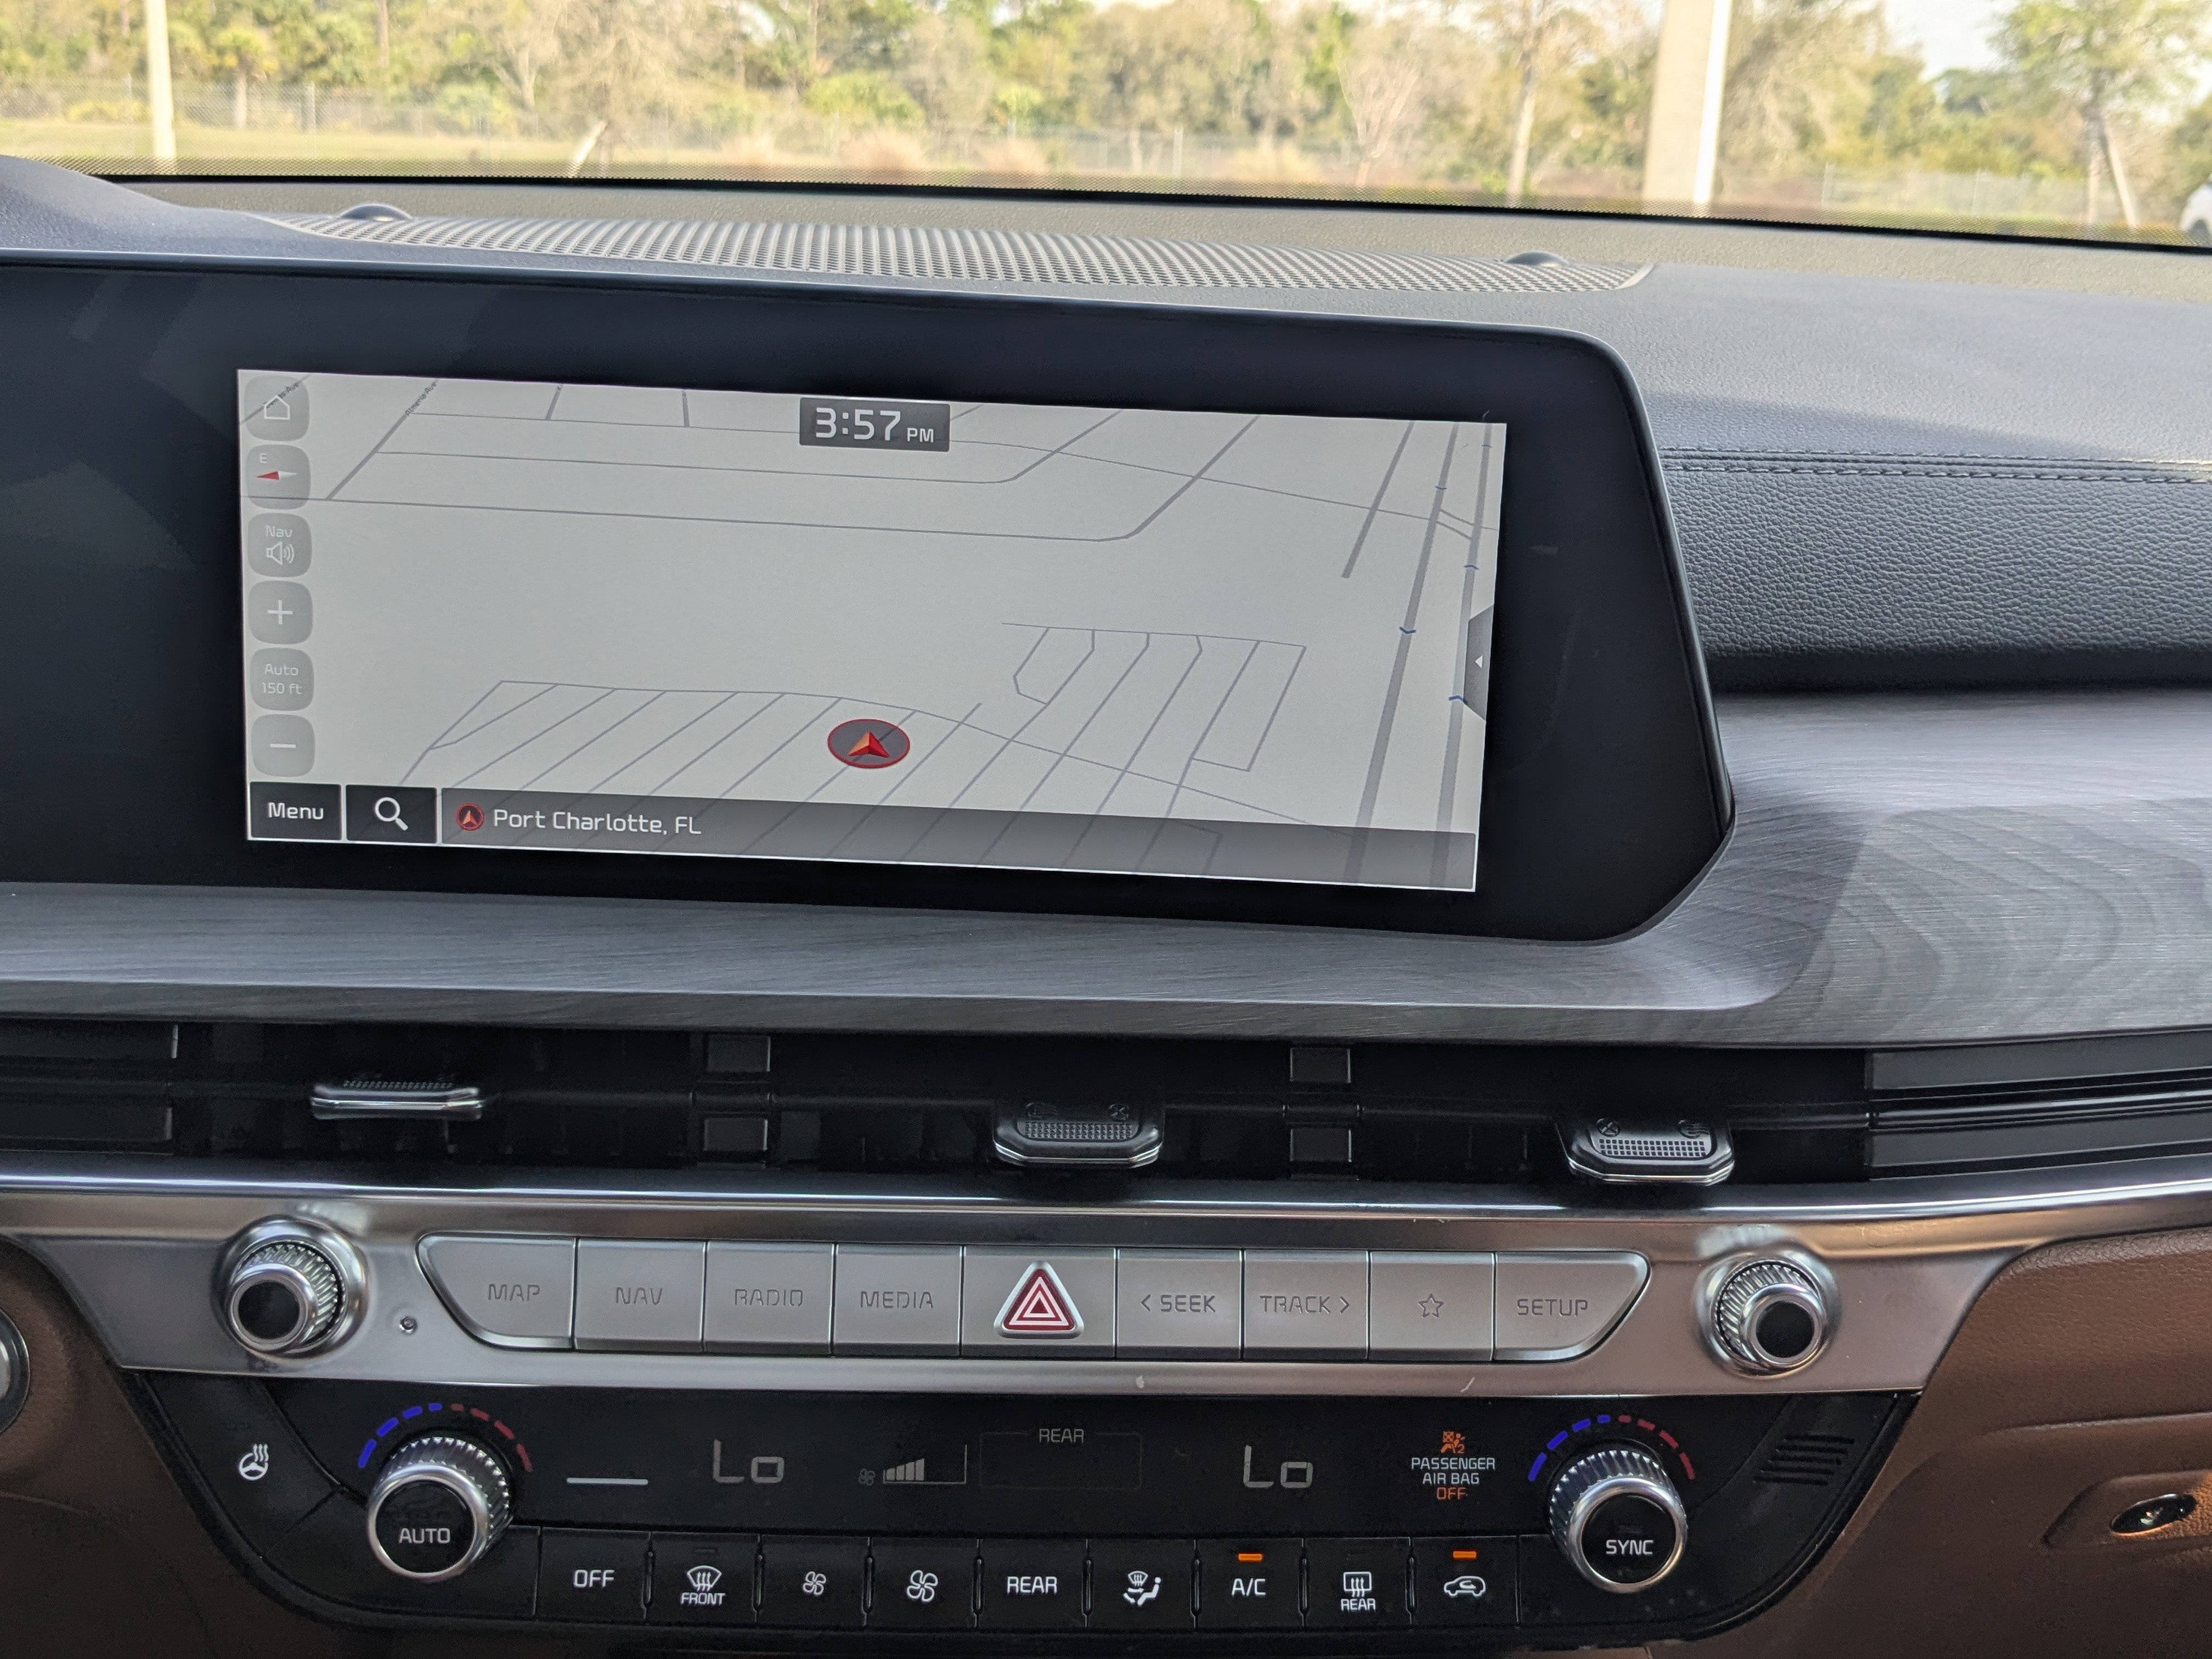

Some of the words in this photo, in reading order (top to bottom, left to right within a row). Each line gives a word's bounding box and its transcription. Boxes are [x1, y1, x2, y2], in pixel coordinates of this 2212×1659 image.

[405, 393, 427, 416] Almeria
[425, 381, 437, 394] Ave
[815, 407, 901, 441] 3:57
[907, 427, 934, 443] PM
[259, 453, 268, 464] E
[265, 525, 294, 538] Nav
[264, 663, 299, 675] Auto
[262, 682, 285, 694] 150
[289, 682, 302, 695] ft
[267, 802, 324, 821] Menu
[493, 809, 546, 829] Port
[552, 811, 668, 836] Charlotte,
[675, 816, 702, 835] FL
[487, 1283, 541, 1302] MAP
[615, 1287, 663, 1305] NAV
[733, 1289, 804, 1307] RADIO
[860, 1290, 934, 1309] MEDIA
[1160, 1295, 1216, 1313] SEEK
[1260, 1295, 1330, 1314] TRACK
[1516, 1298, 1588, 1317] SETUP
[1039, 1428, 1085, 1443] REAR
[713, 1439, 785, 1483] Lo
[1243, 1444, 1313, 1488] Lo
[1411, 1457, 1496, 1470] PASSENGER
[1422, 1472, 1446, 1485] AIR
[1451, 1472, 1480, 1485] BAG
[1436, 1487, 1466, 1500] OFF
[398, 1527, 451, 1545] AUTO
[1605, 1539, 1654, 1555] SYNC
[573, 1569, 615, 1589] OFF
[1007, 1577, 1058, 1595] REAR
[1232, 1578, 1267, 1597] A/C
[680, 1592, 726, 1606] FRONT
[1340, 1598, 1376, 1612] REAR
